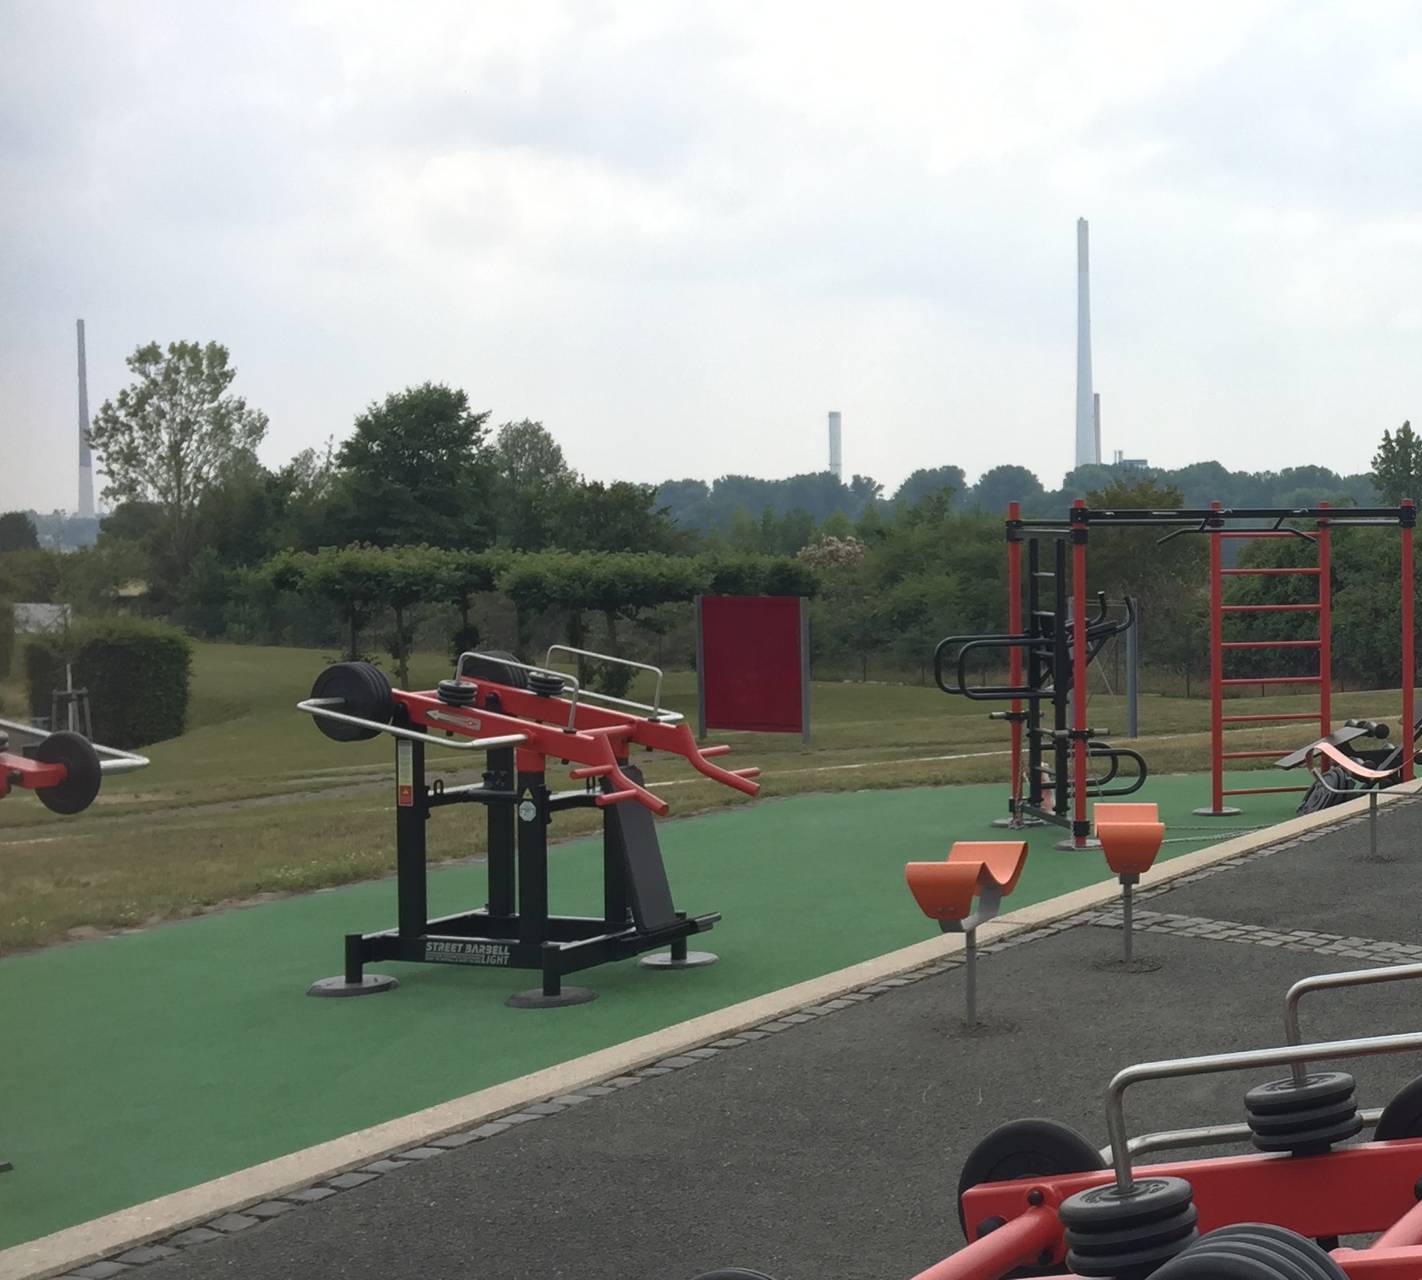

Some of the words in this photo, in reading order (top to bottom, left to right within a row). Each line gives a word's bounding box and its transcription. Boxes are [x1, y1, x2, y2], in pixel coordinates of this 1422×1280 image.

[425, 942, 463, 953] STREET
[464, 943, 510, 955] BARBELL
[480, 955, 509, 965] LIGHT
